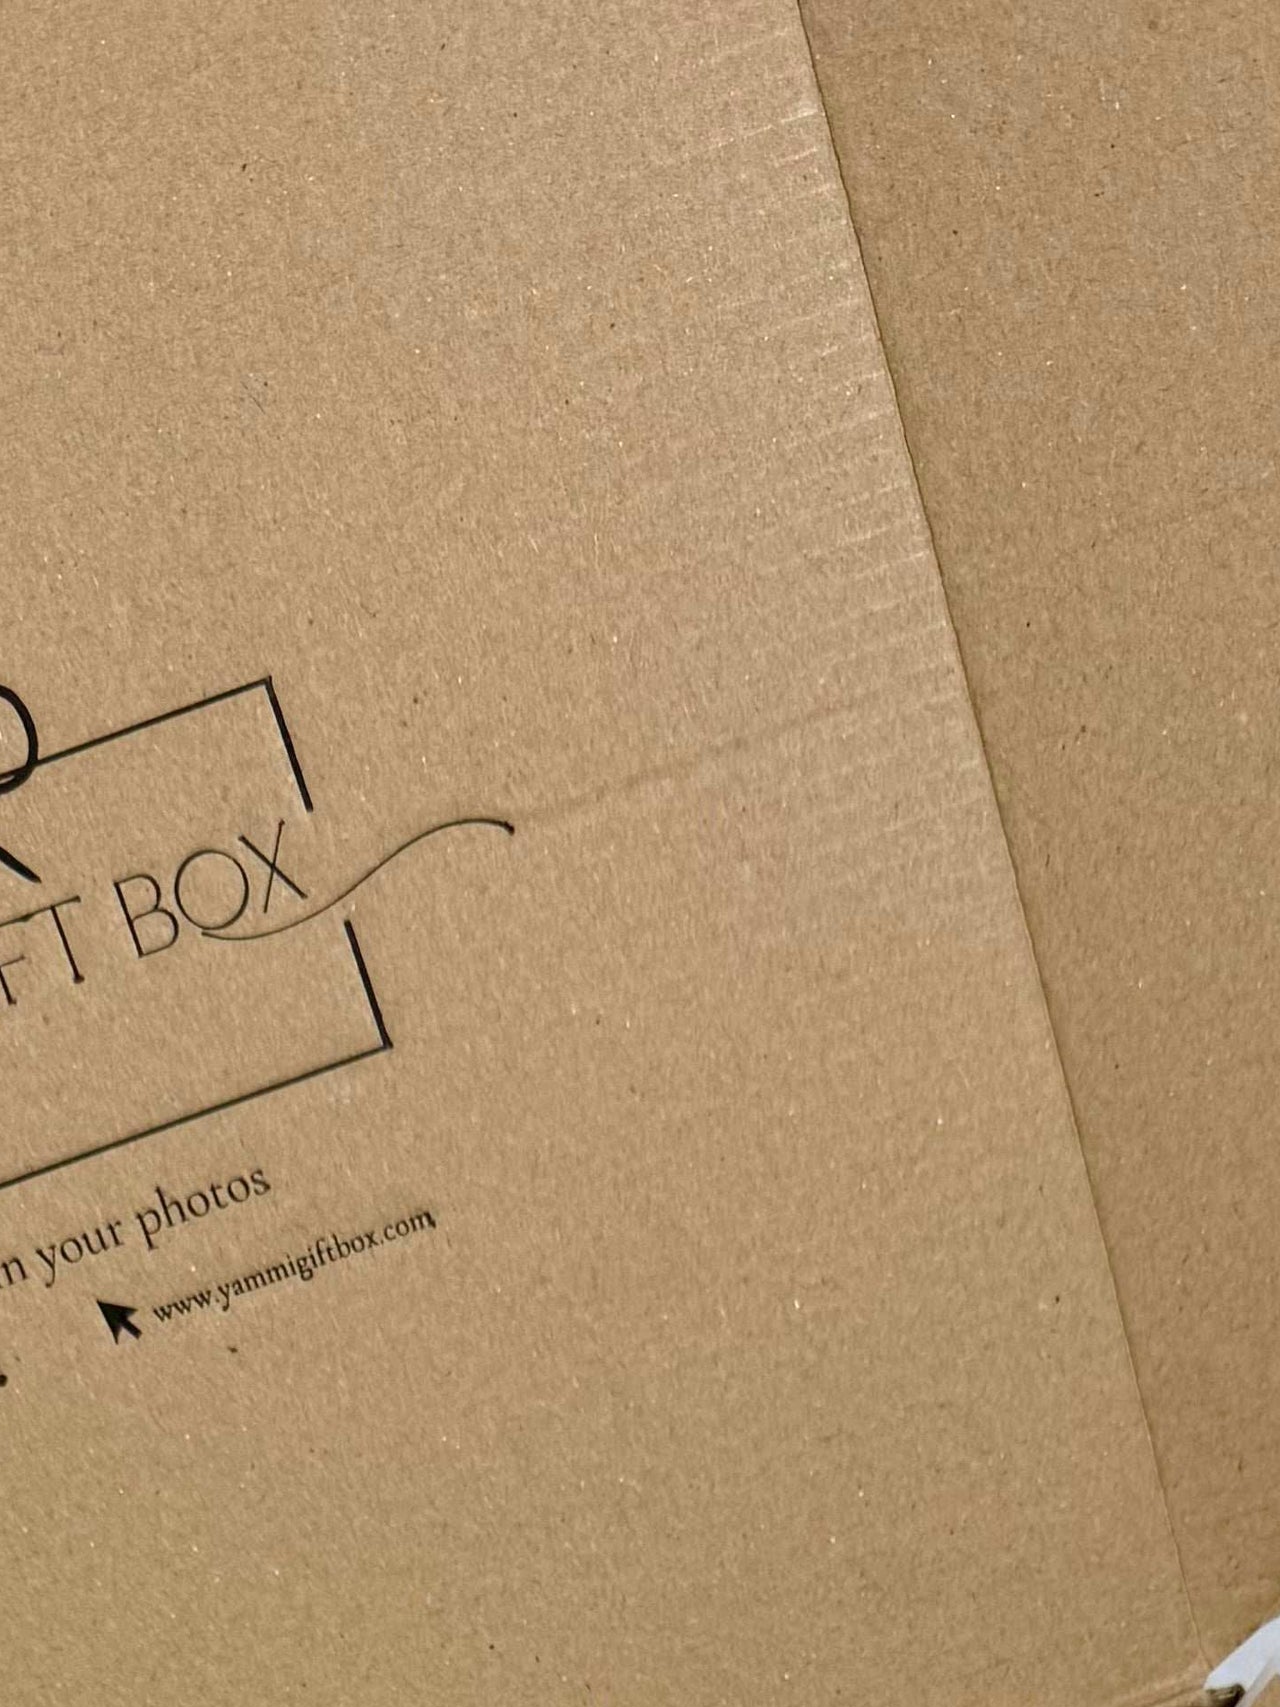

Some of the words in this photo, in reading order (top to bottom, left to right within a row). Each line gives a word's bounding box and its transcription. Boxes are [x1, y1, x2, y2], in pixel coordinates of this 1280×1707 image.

[113, 819, 308, 959] BOX
[35, 1218, 126, 1288] your
[135, 1167, 271, 1250] photos
[152, 1210, 437, 1323] www.yammigiftbox.com
